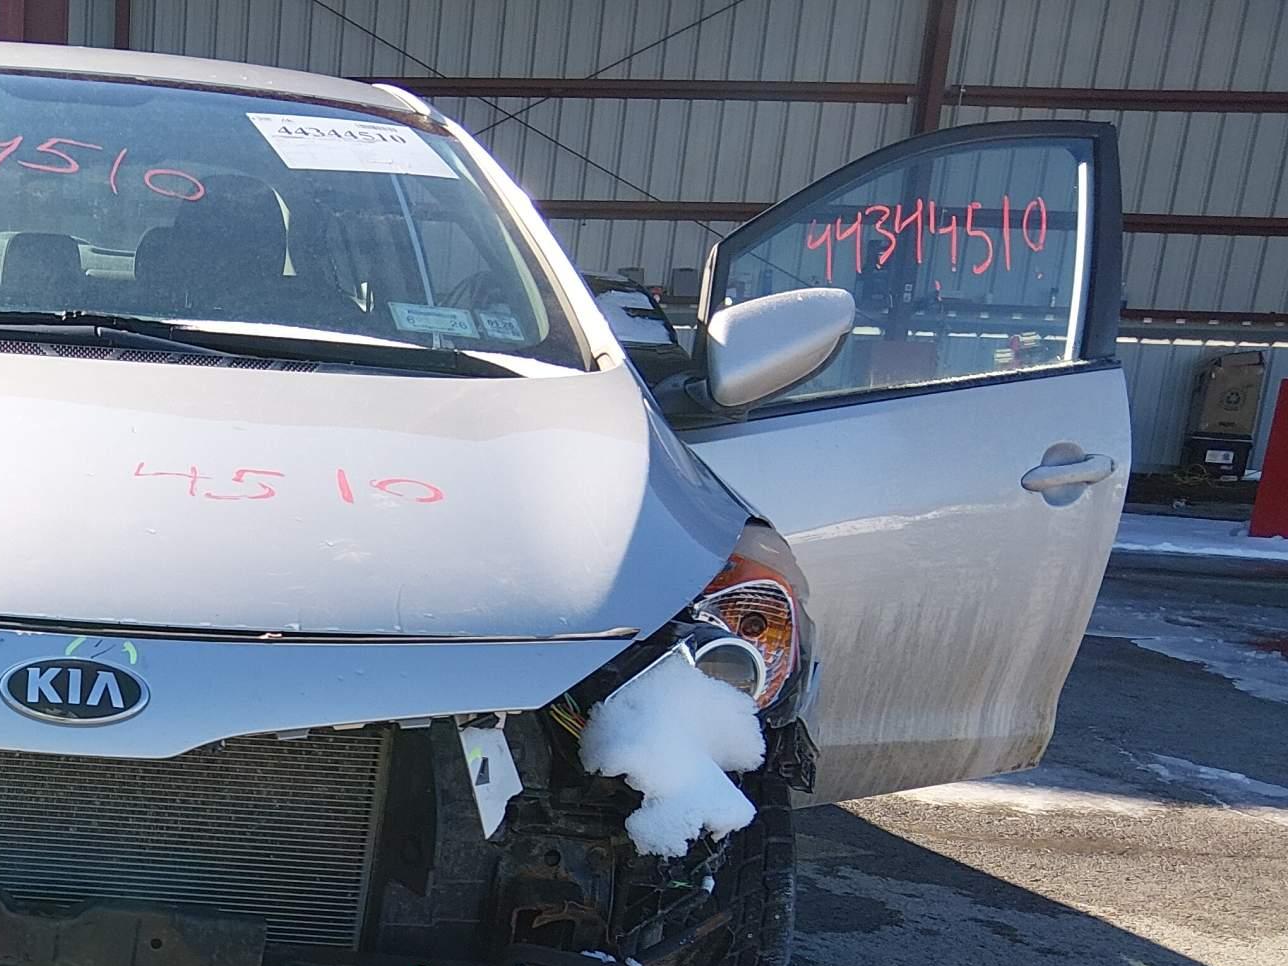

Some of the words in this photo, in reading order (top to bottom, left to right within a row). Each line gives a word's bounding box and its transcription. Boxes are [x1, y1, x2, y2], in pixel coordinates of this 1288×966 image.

[277, 126, 407, 144] 44344510
[806, 193, 1048, 284] 44344510
[26, 667, 125, 709] KIA
